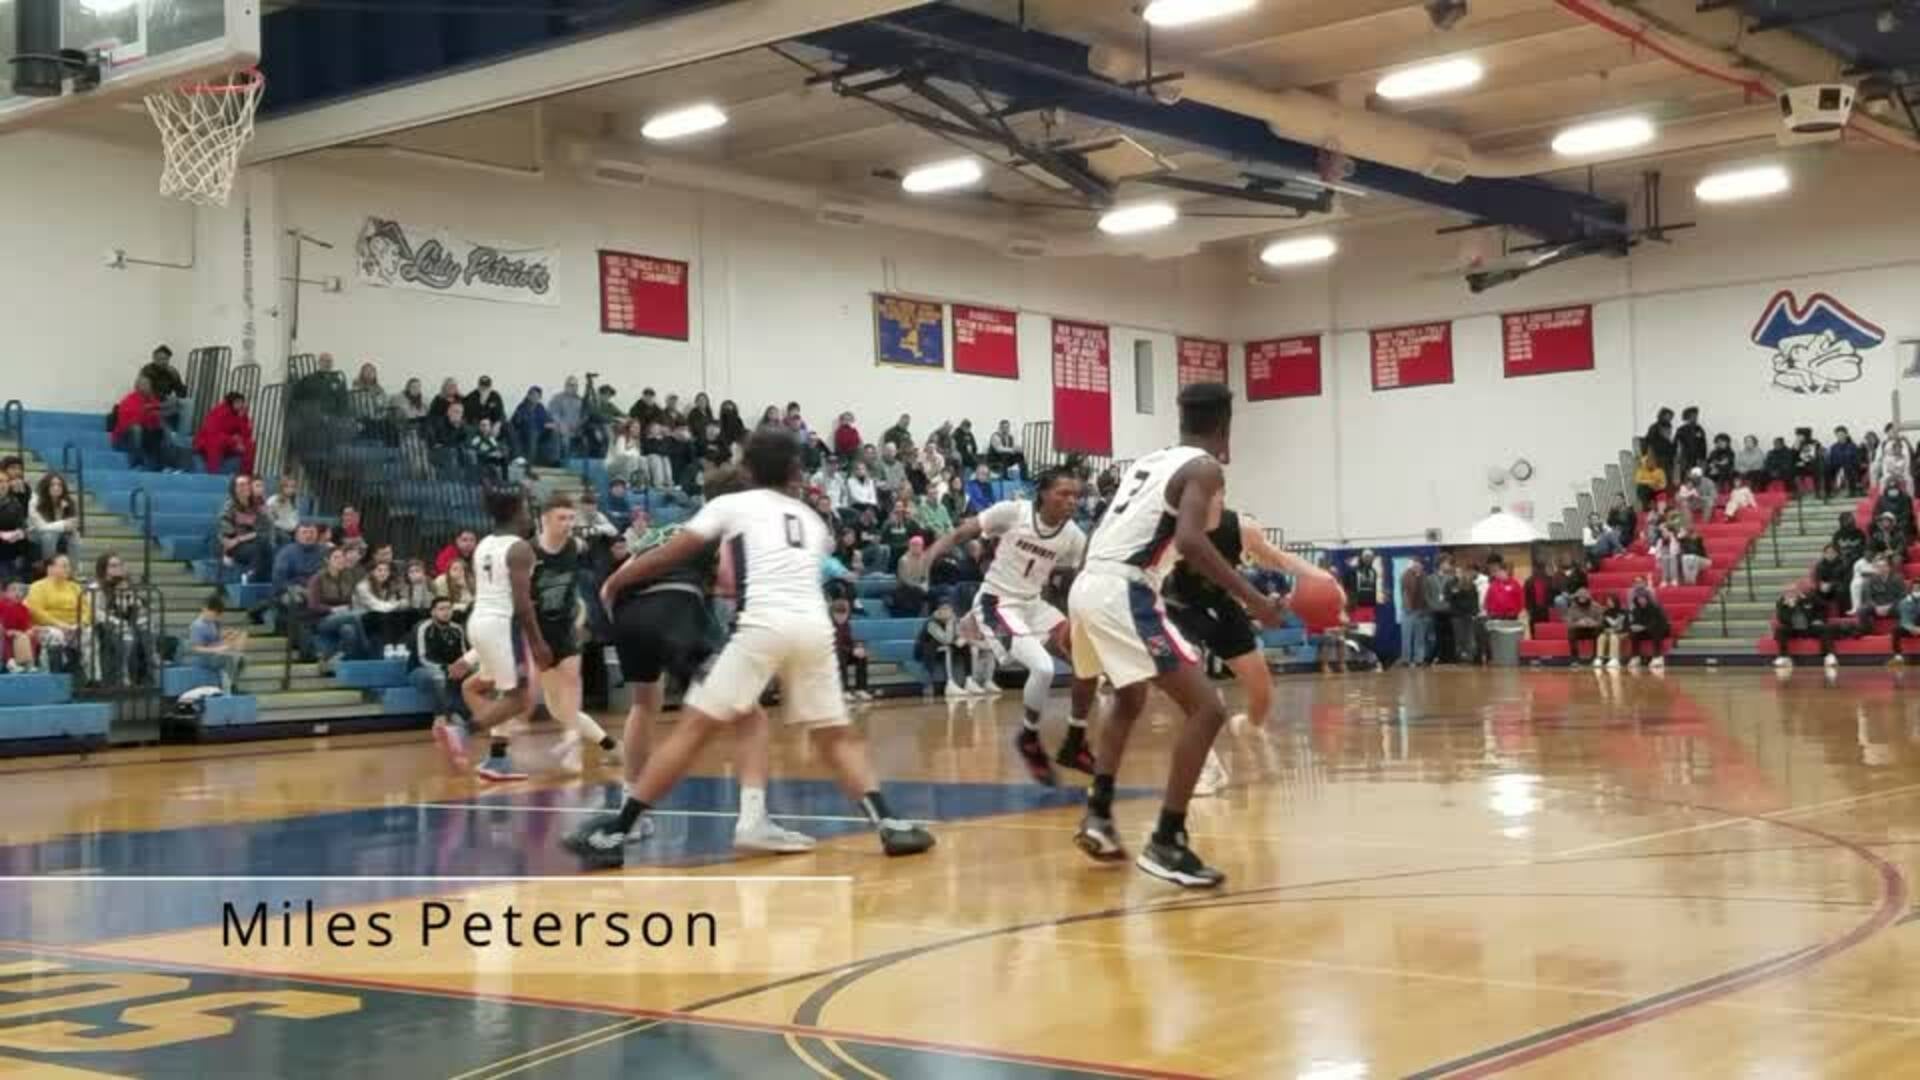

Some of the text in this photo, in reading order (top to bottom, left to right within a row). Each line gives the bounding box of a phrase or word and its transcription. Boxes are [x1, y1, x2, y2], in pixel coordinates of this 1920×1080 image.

[400, 239, 462, 290] Lady
[464, 246, 550, 295] Patriots
[784, 513, 804, 548] 0
[1024, 558, 1036, 578] 1
